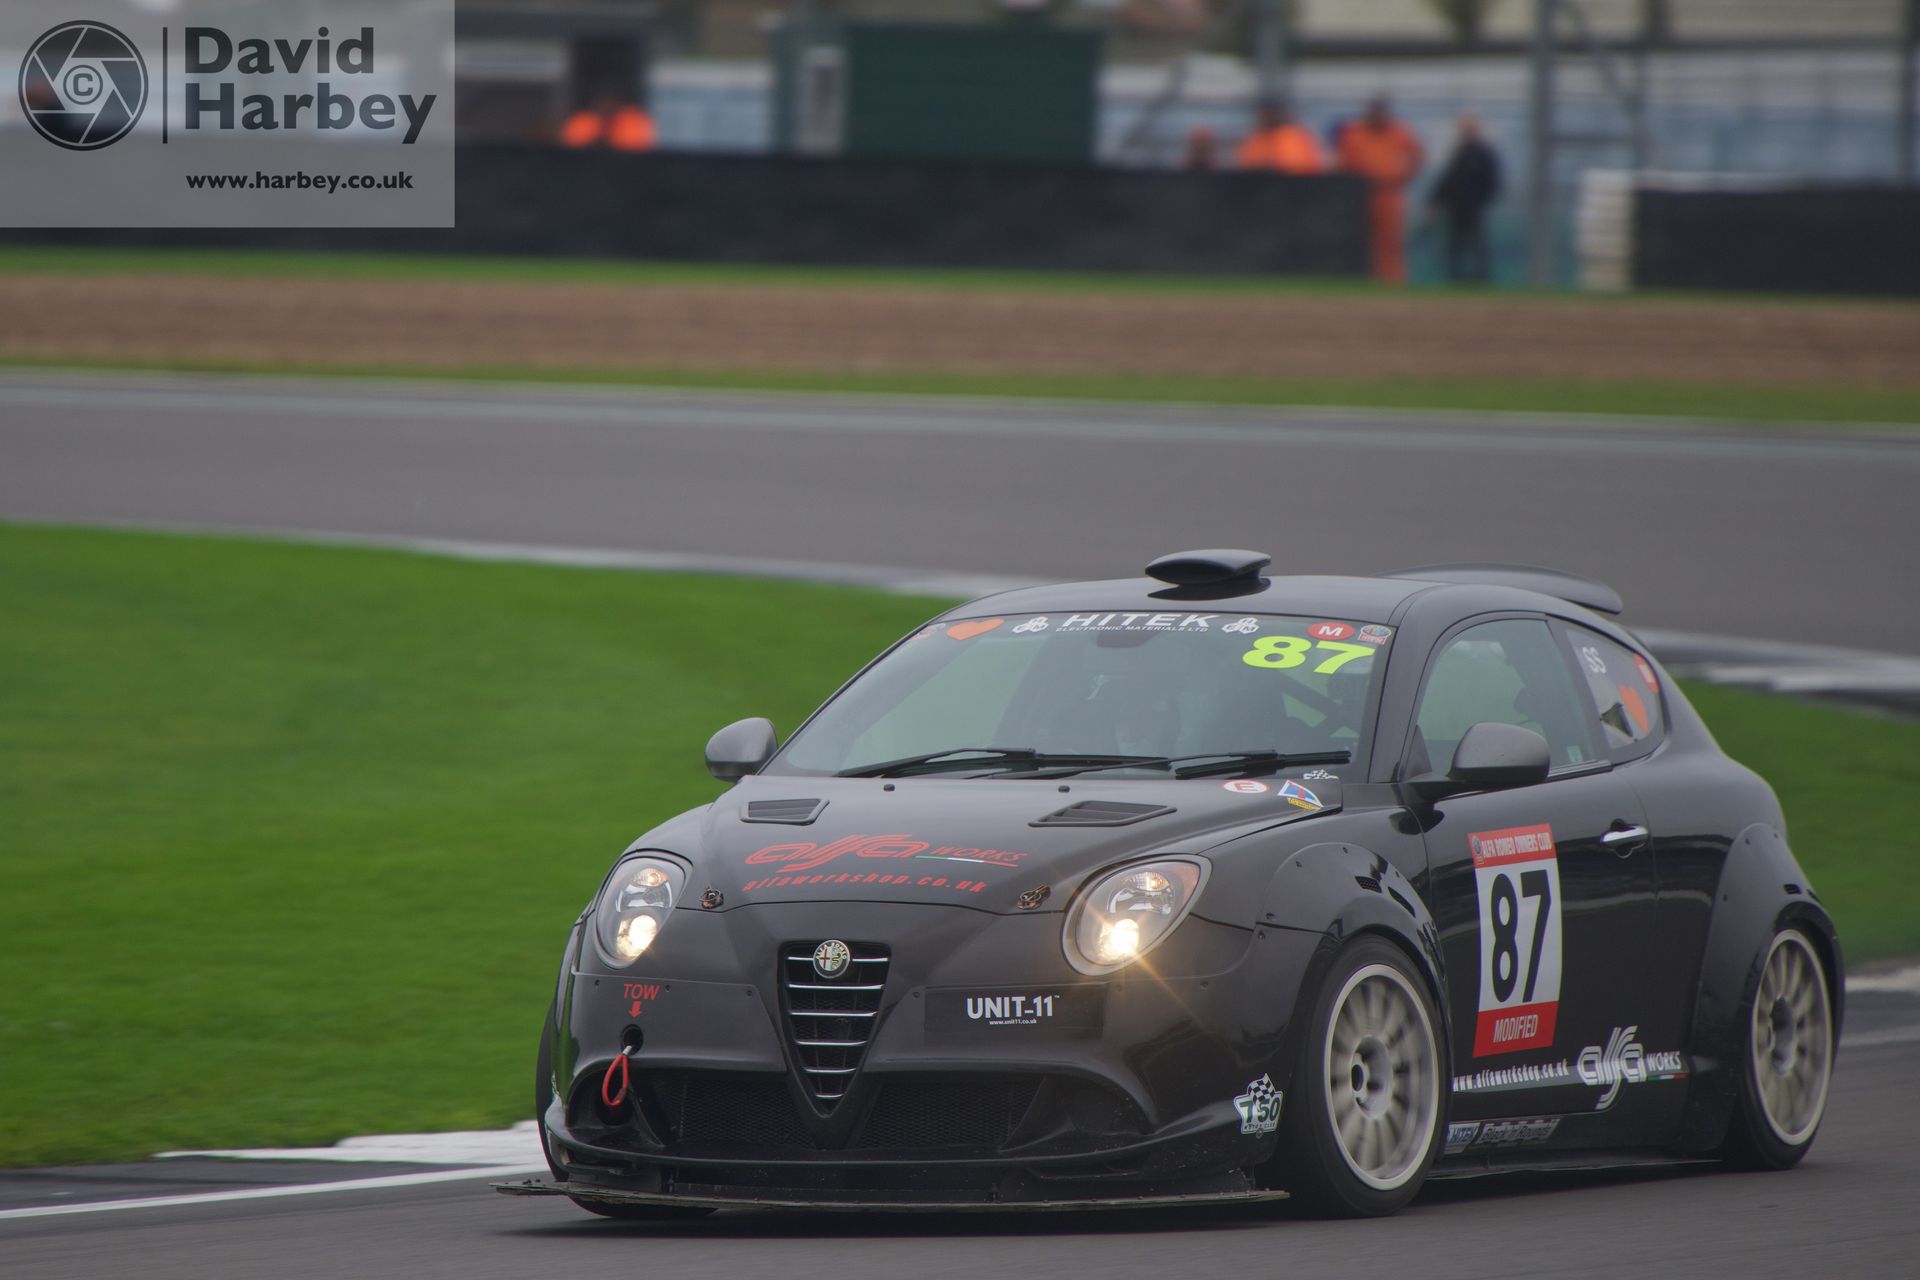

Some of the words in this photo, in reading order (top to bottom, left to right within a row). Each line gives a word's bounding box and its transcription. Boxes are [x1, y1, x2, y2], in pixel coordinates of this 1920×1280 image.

[1061, 613, 1220, 628] HITEK
[1318, 625, 1344, 637] M
[1242, 635, 1376, 675] 87
[929, 846, 1028, 862] WORKS
[742, 873, 987, 893] alfaworkshop.co.uk
[1491, 869, 1552, 1004] 87
[623, 983, 660, 1000] TOW
[966, 995, 1053, 1020] UNIT-11
[1493, 1014, 1539, 1043] MODIFIED
[1646, 1050, 1682, 1072] WORKS
[1239, 1097, 1280, 1123] 750
